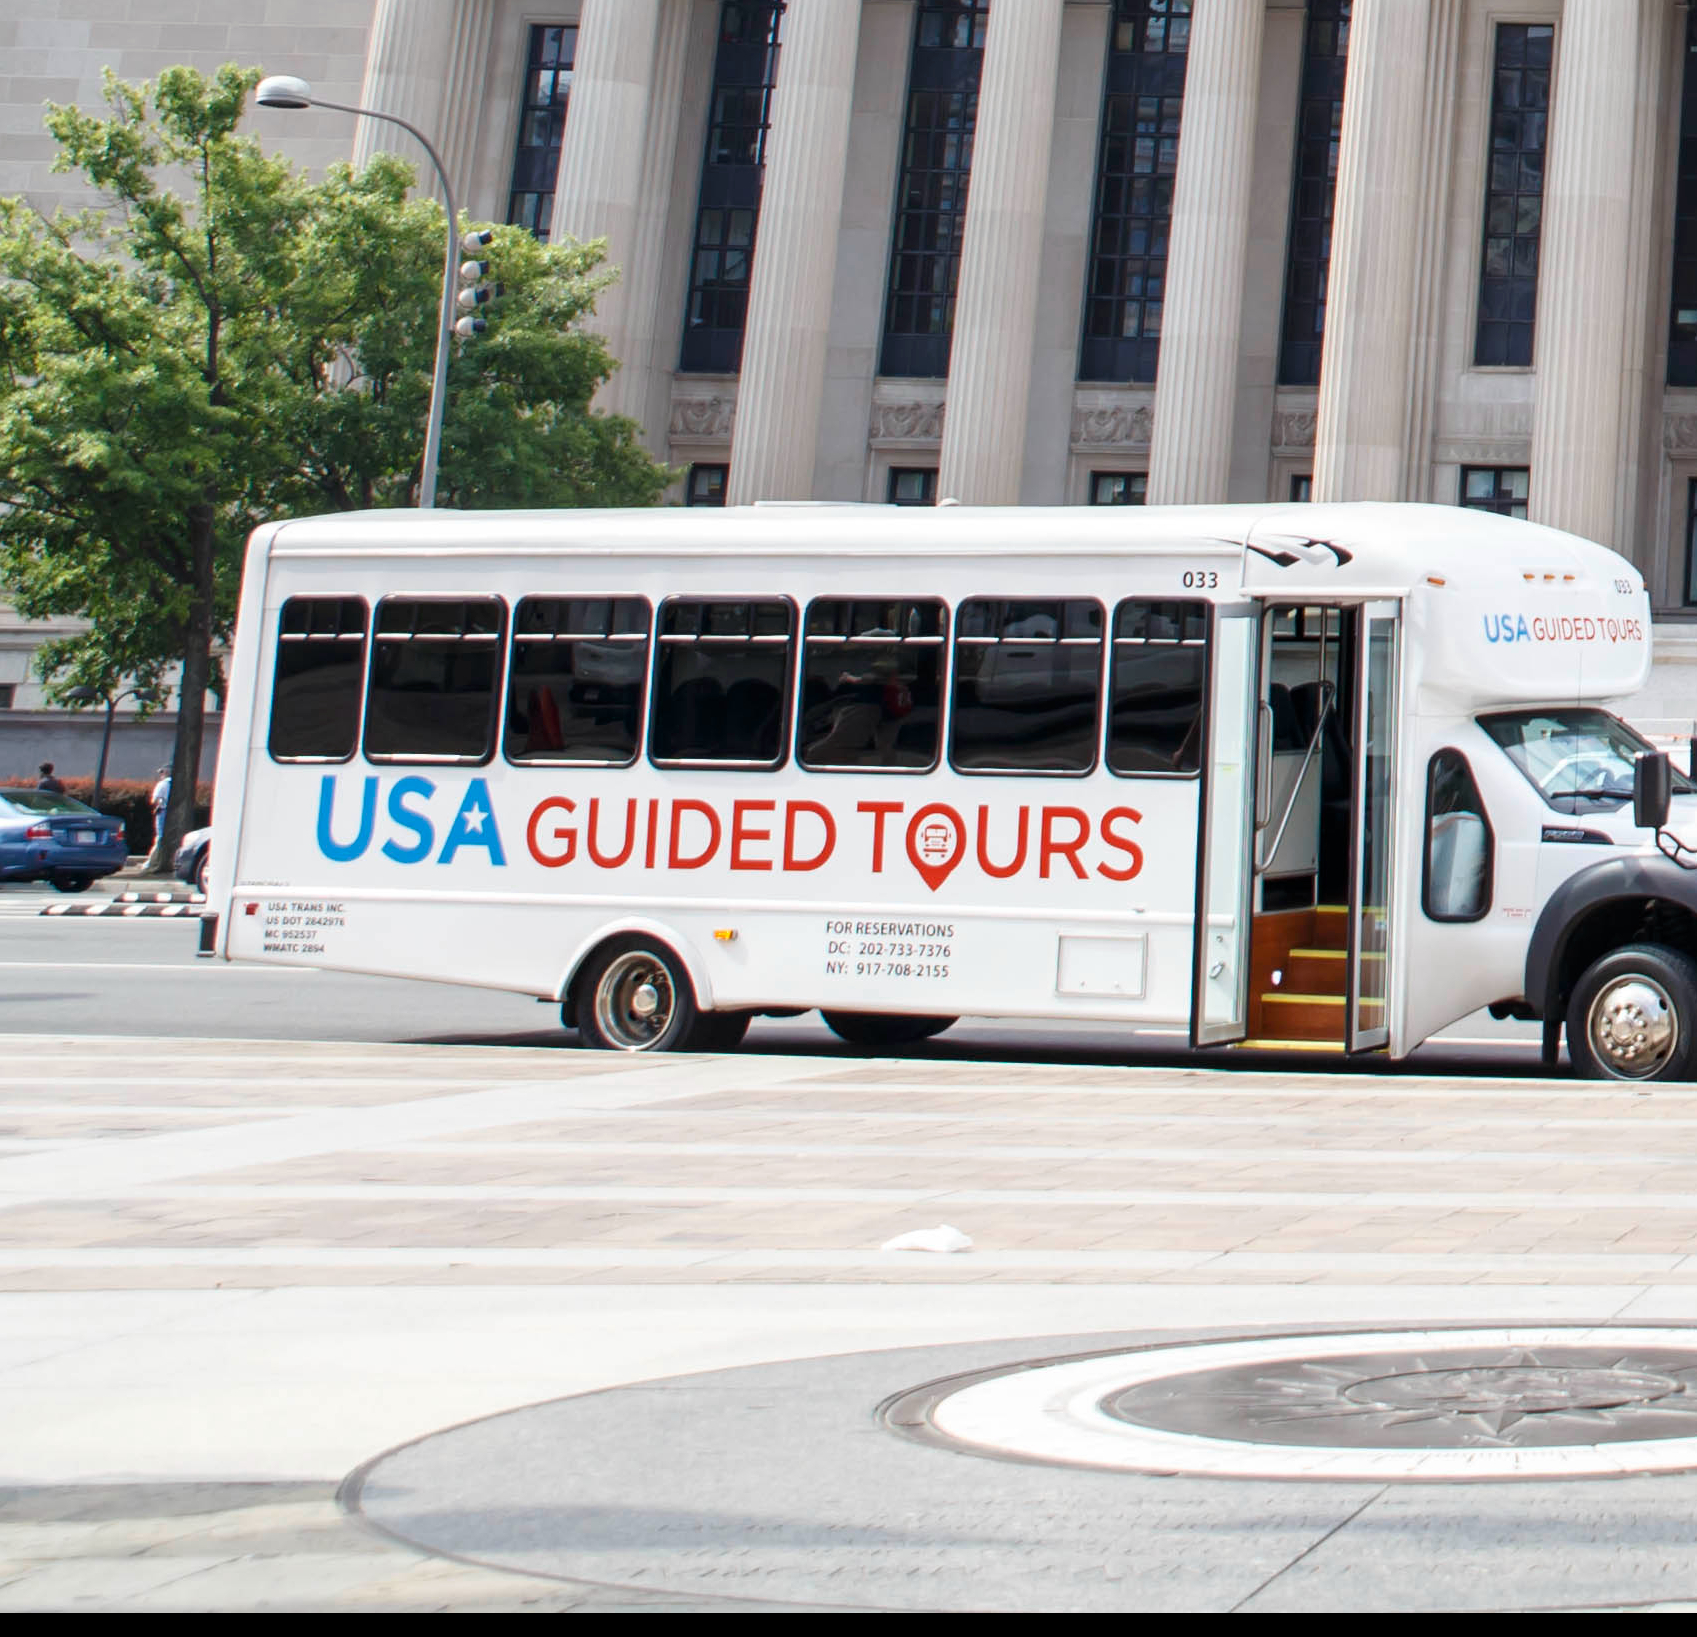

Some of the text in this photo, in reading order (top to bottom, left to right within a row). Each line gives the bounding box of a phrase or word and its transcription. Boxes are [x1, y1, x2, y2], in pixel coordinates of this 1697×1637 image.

[1183, 571, 1218, 589] 033
[1484, 614, 1643, 643] USA GUIDED TOURS
[316, 776, 1143, 891] USA GUIDED TOURS
[268, 902, 288, 912] USA
[291, 903, 324, 912] TRANS
[266, 916, 345, 926] US DOT 2842976
[264, 930, 318, 939] MC 952537
[826, 921, 955, 938] FOR RESERVATIONS
[263, 943, 299, 953] WMATC
[828, 941, 951, 957] DC: 202-733-7376
[826, 961, 949, 978] NY: 917-708-2155
